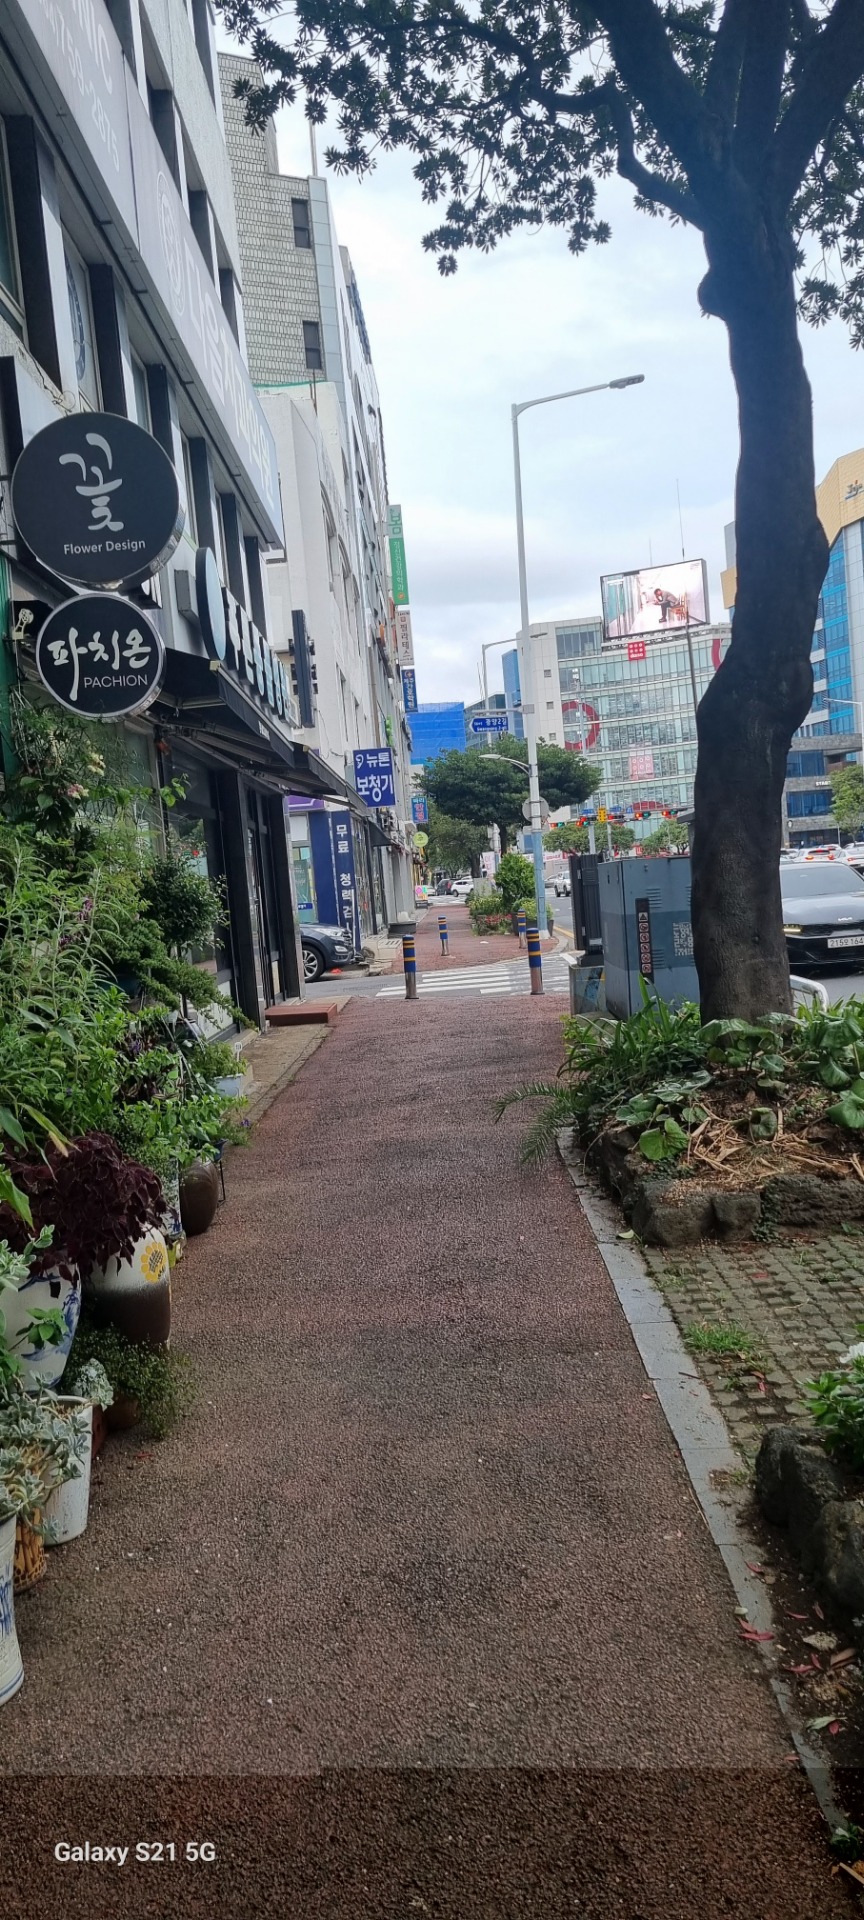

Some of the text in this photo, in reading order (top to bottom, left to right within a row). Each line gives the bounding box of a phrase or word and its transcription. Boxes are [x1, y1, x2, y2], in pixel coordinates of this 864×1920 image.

[184, 237, 275, 511] 다음치과의원
[59, 432, 124, 532] 꽃
[388, 512, 402, 535] 봄
[63, 539, 146, 555] Flower Design
[46, 627, 152, 701] 파치온
[84, 674, 148, 688] PACHION
[366, 751, 390, 768] 뉴톤
[357, 774, 393, 802] 보청기
[336, 824, 350, 853] 무료
